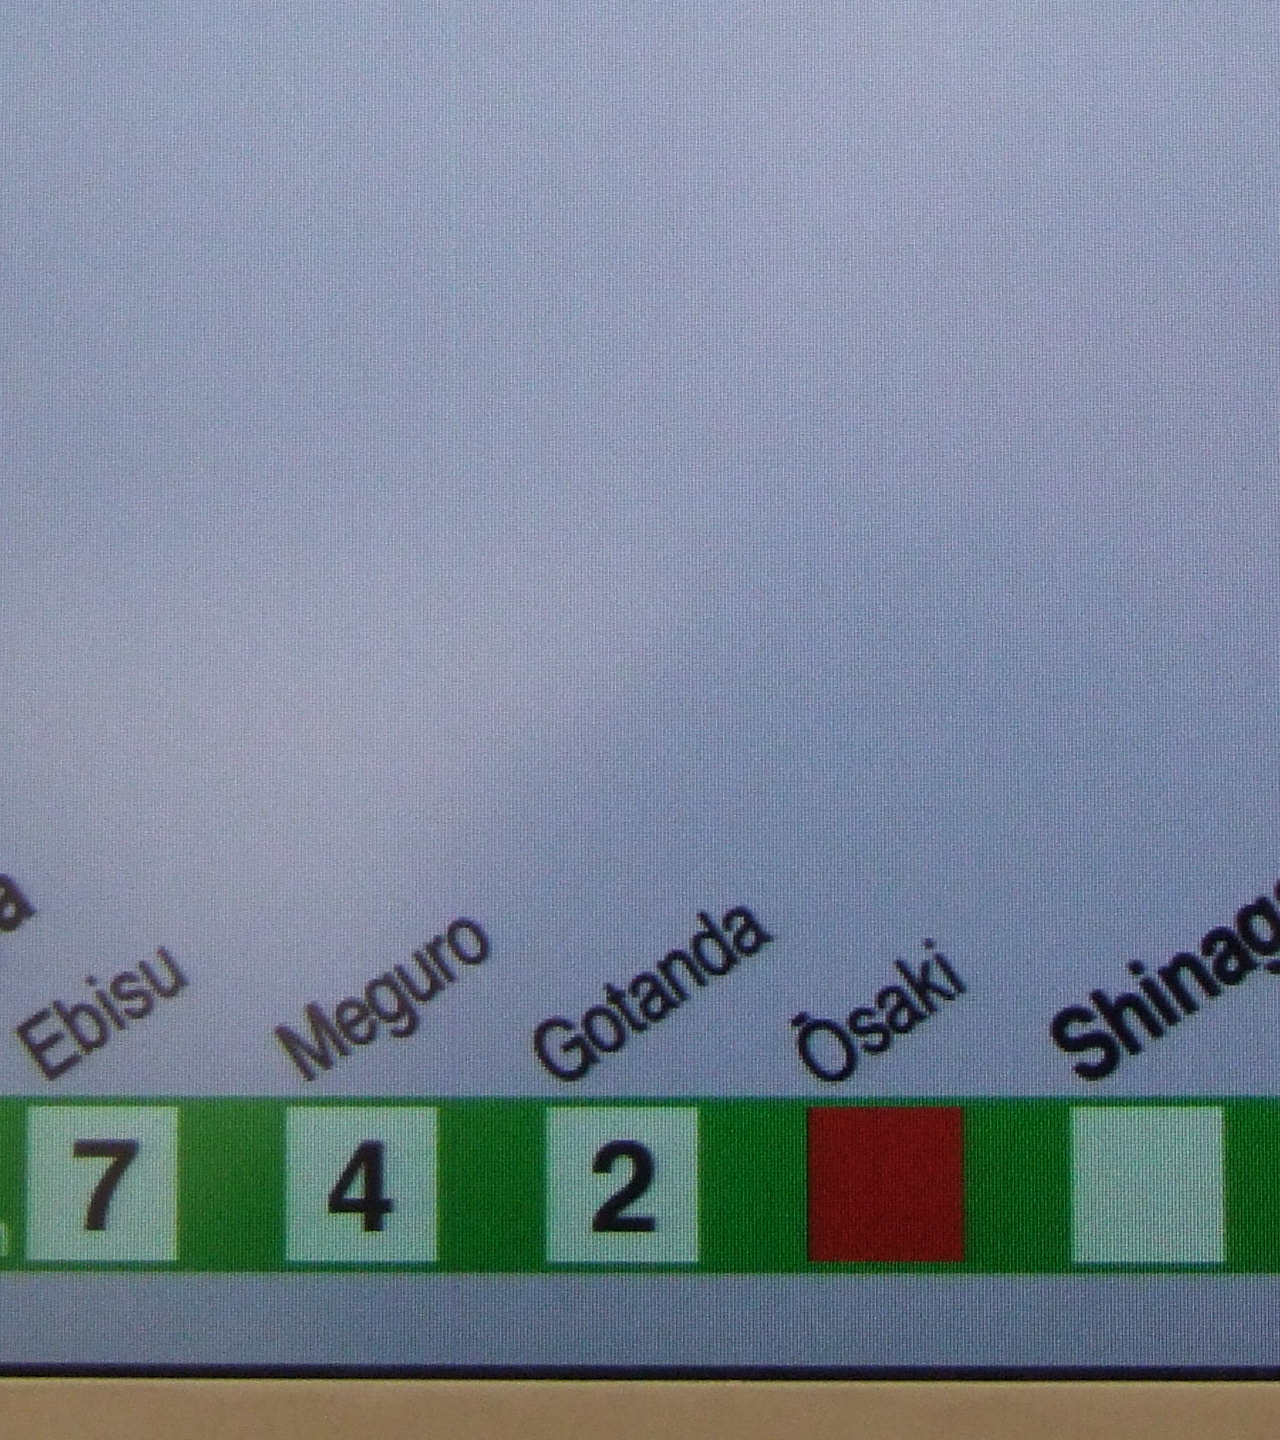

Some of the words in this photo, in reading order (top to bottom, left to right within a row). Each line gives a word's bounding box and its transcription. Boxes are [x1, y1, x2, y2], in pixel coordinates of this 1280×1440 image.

[14, 943, 190, 1083] Ebisu
[277, 915, 492, 1083] Meguro
[532, 902, 773, 1084] Gotanda
[790, 938, 970, 1087] Ōsaki
[72, 1139, 139, 1233] 7
[327, 1141, 392, 1233] 4
[589, 1141, 658, 1235] 2
